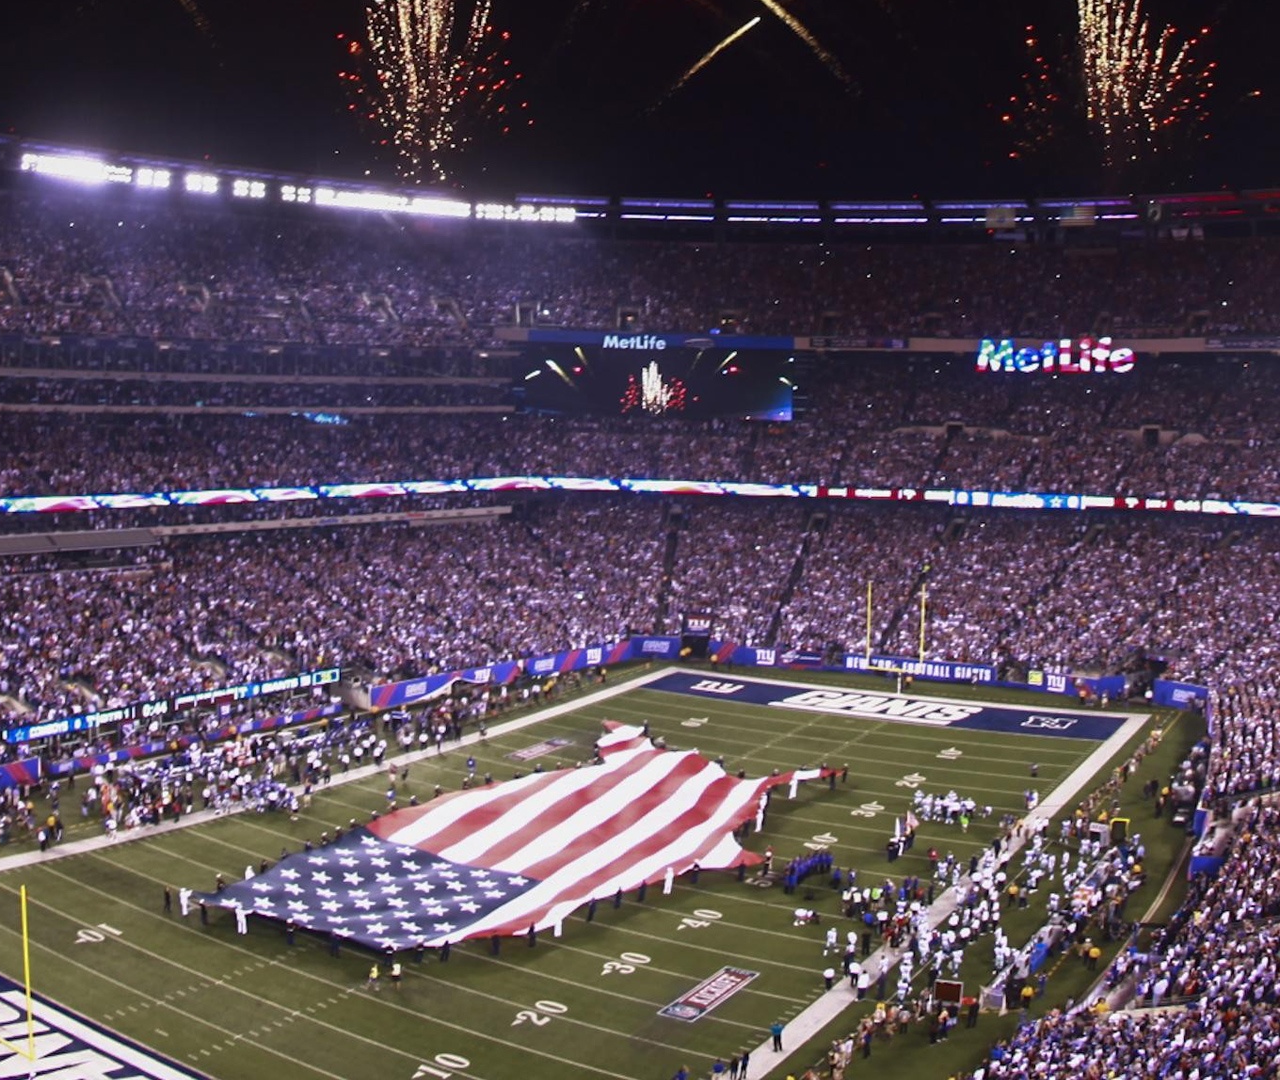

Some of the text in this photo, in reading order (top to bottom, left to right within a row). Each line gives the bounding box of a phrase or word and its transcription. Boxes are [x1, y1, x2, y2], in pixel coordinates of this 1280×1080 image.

[602, 334, 667, 350] MetLife
[975, 336, 1136, 373] MetLife
[902, 660, 950, 678] FOOTBALL
[782, 690, 983, 721] GIANTS
[688, 909, 724, 929] 40
[611, 952, 652, 974] 30
[520, 1000, 569, 1027] 20
